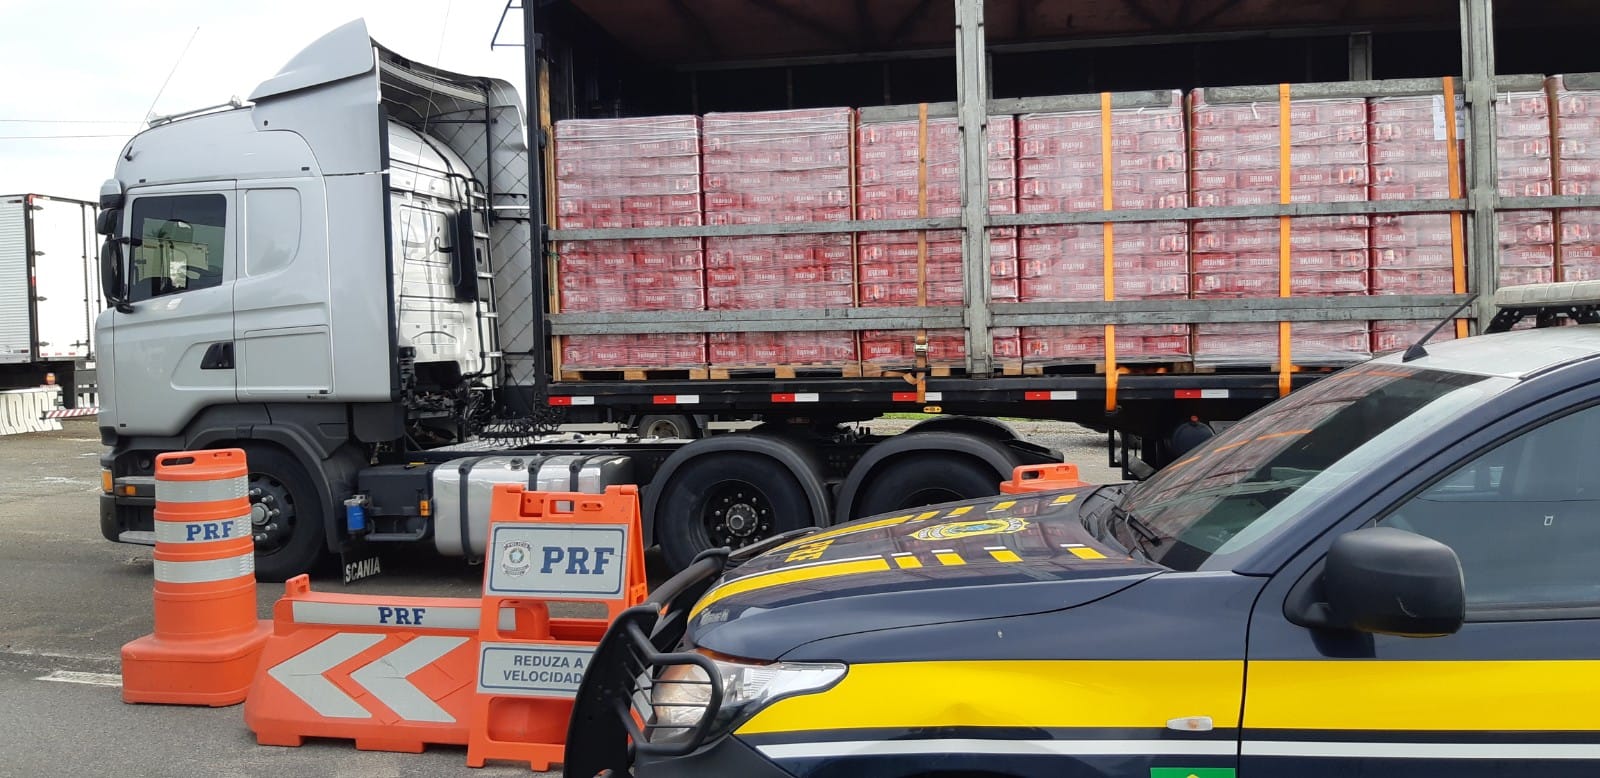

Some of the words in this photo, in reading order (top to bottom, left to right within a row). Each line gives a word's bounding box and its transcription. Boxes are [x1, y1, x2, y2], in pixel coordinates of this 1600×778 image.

[186, 520, 234, 541] PRF
[345, 556, 381, 583] SCANIA
[540, 546, 615, 574] PRF
[378, 606, 425, 625] PRF
[513, 654, 570, 668] REDUZA
[574, 657, 584, 669] A
[503, 670, 584, 684] VELOCIDAD
